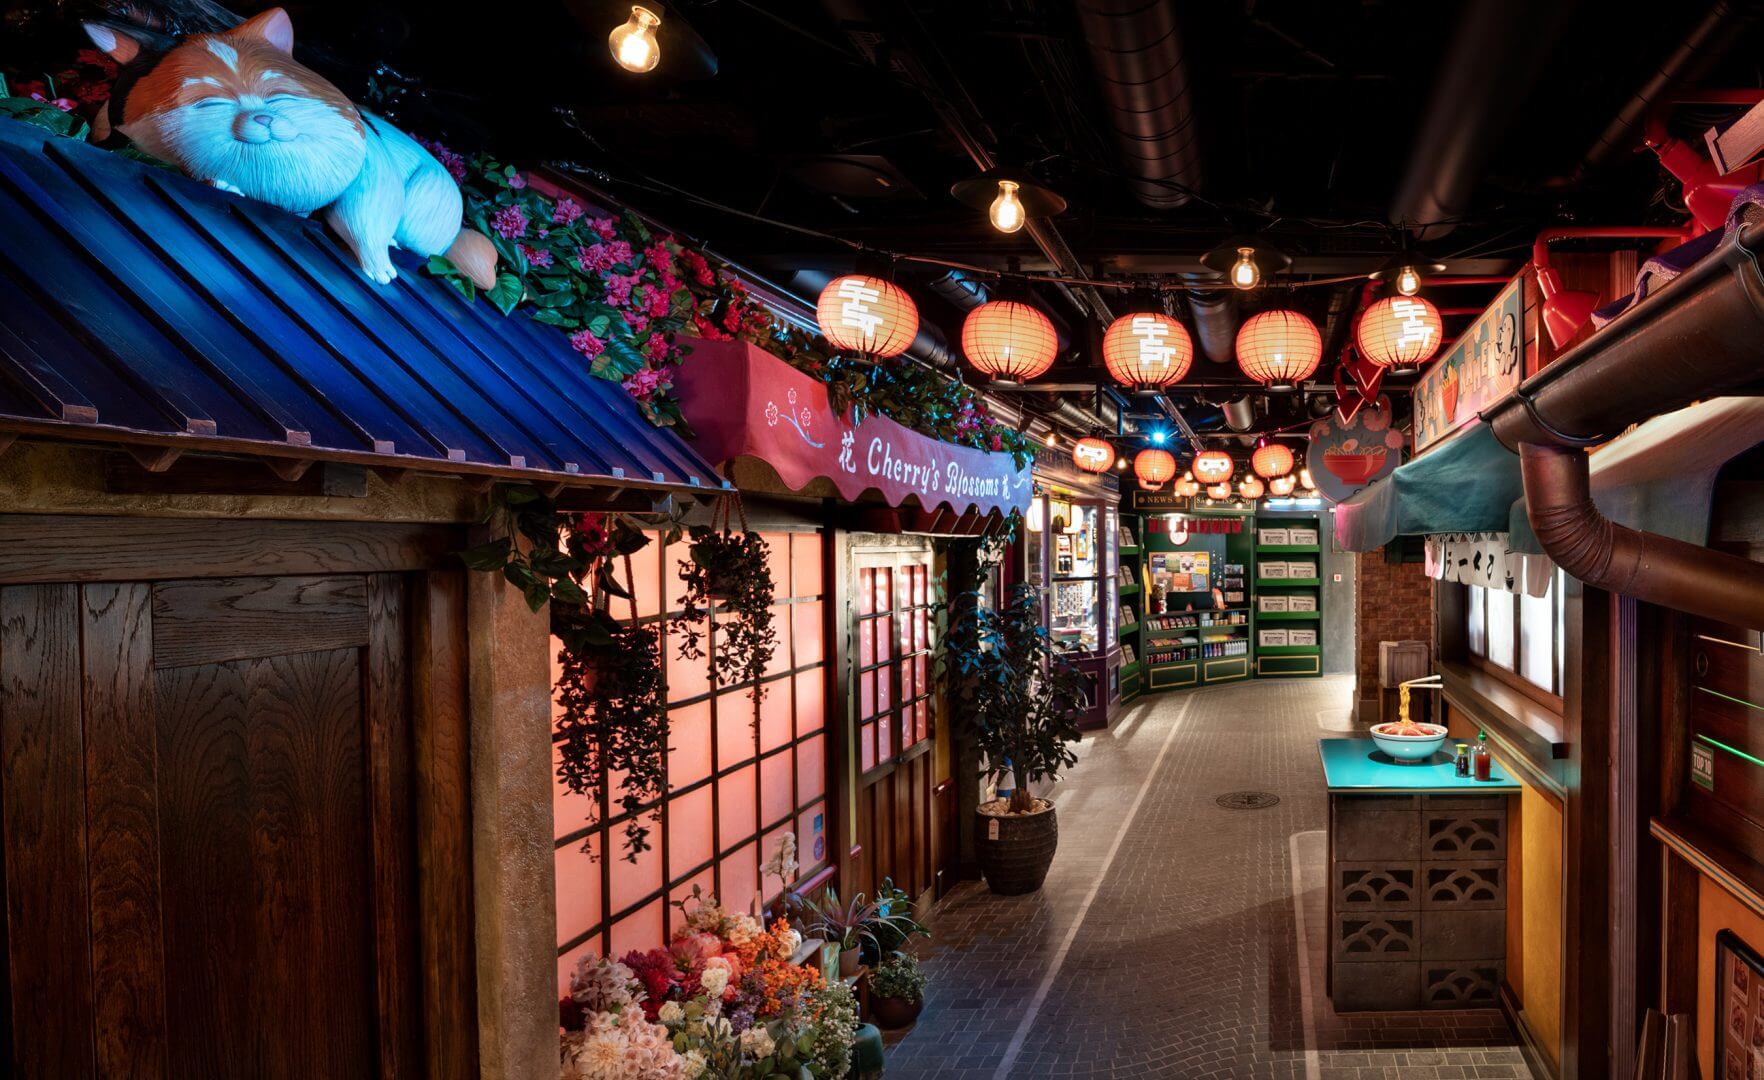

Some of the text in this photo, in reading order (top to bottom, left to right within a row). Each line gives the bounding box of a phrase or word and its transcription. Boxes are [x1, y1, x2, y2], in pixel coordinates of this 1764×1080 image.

[867, 437, 940, 495] Cherry's
[945, 461, 999, 498] Blossoms
[1147, 496, 1173, 504] NEWS
[1693, 752, 1704, 771] TOP
[1705, 758, 1712, 776] 10
